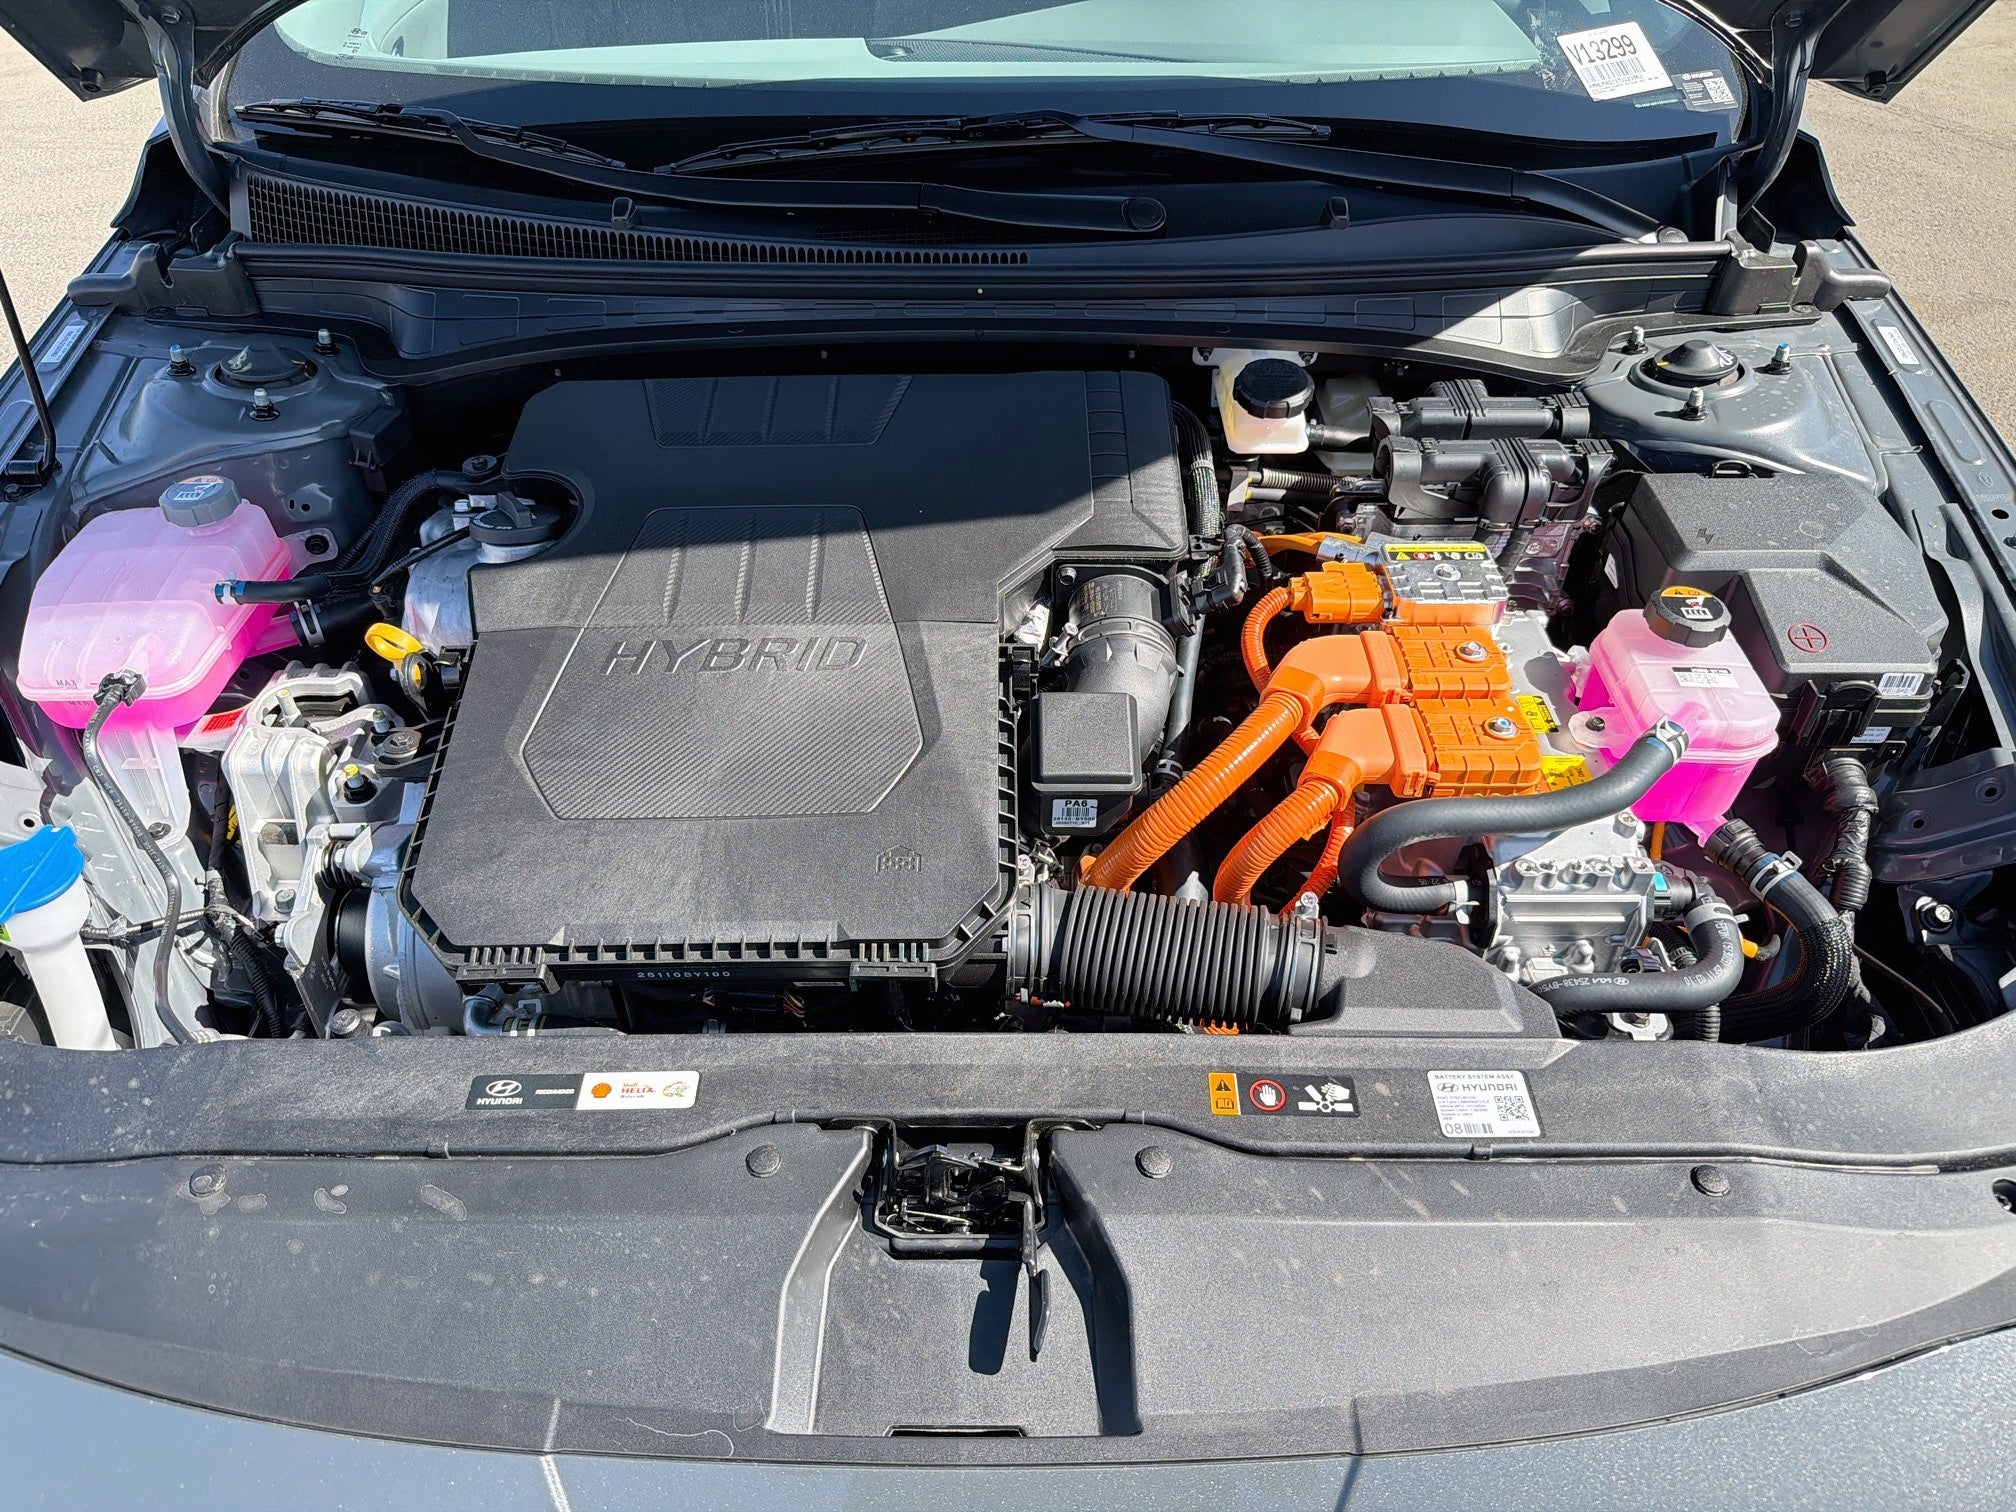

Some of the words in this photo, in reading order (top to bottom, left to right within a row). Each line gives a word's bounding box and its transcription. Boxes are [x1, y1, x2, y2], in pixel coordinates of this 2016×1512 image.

[1566, 35, 1637, 66] V13299
[600, 636, 869, 676] HYBRID
[1064, 799, 1089, 807] PA6
[621, 1085, 655, 1094] HELIX
[476, 1097, 524, 1105] HYUNDAI
[1444, 1122, 1464, 1135] 08
